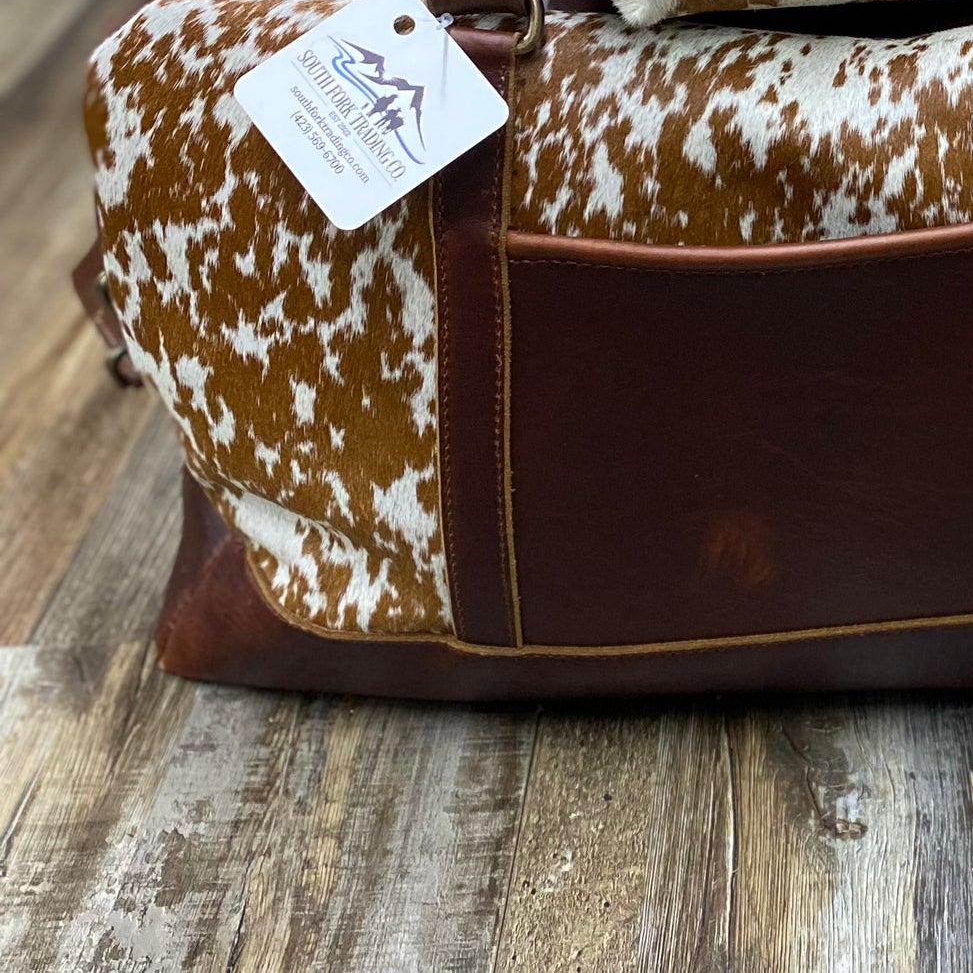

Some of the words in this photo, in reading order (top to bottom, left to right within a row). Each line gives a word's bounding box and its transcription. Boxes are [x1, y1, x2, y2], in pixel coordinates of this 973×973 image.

[290, 85, 370, 184] southforktradingco.com
[290, 110, 313, 136] (423)
[307, 131, 344, 174] 569-6700
[297, 49, 336, 90] SOUTH
[325, 84, 358, 120] FORK
[349, 112, 395, 165] TRADING
[386, 160, 406, 182] CO.
[327, 111, 341, 124] EST
